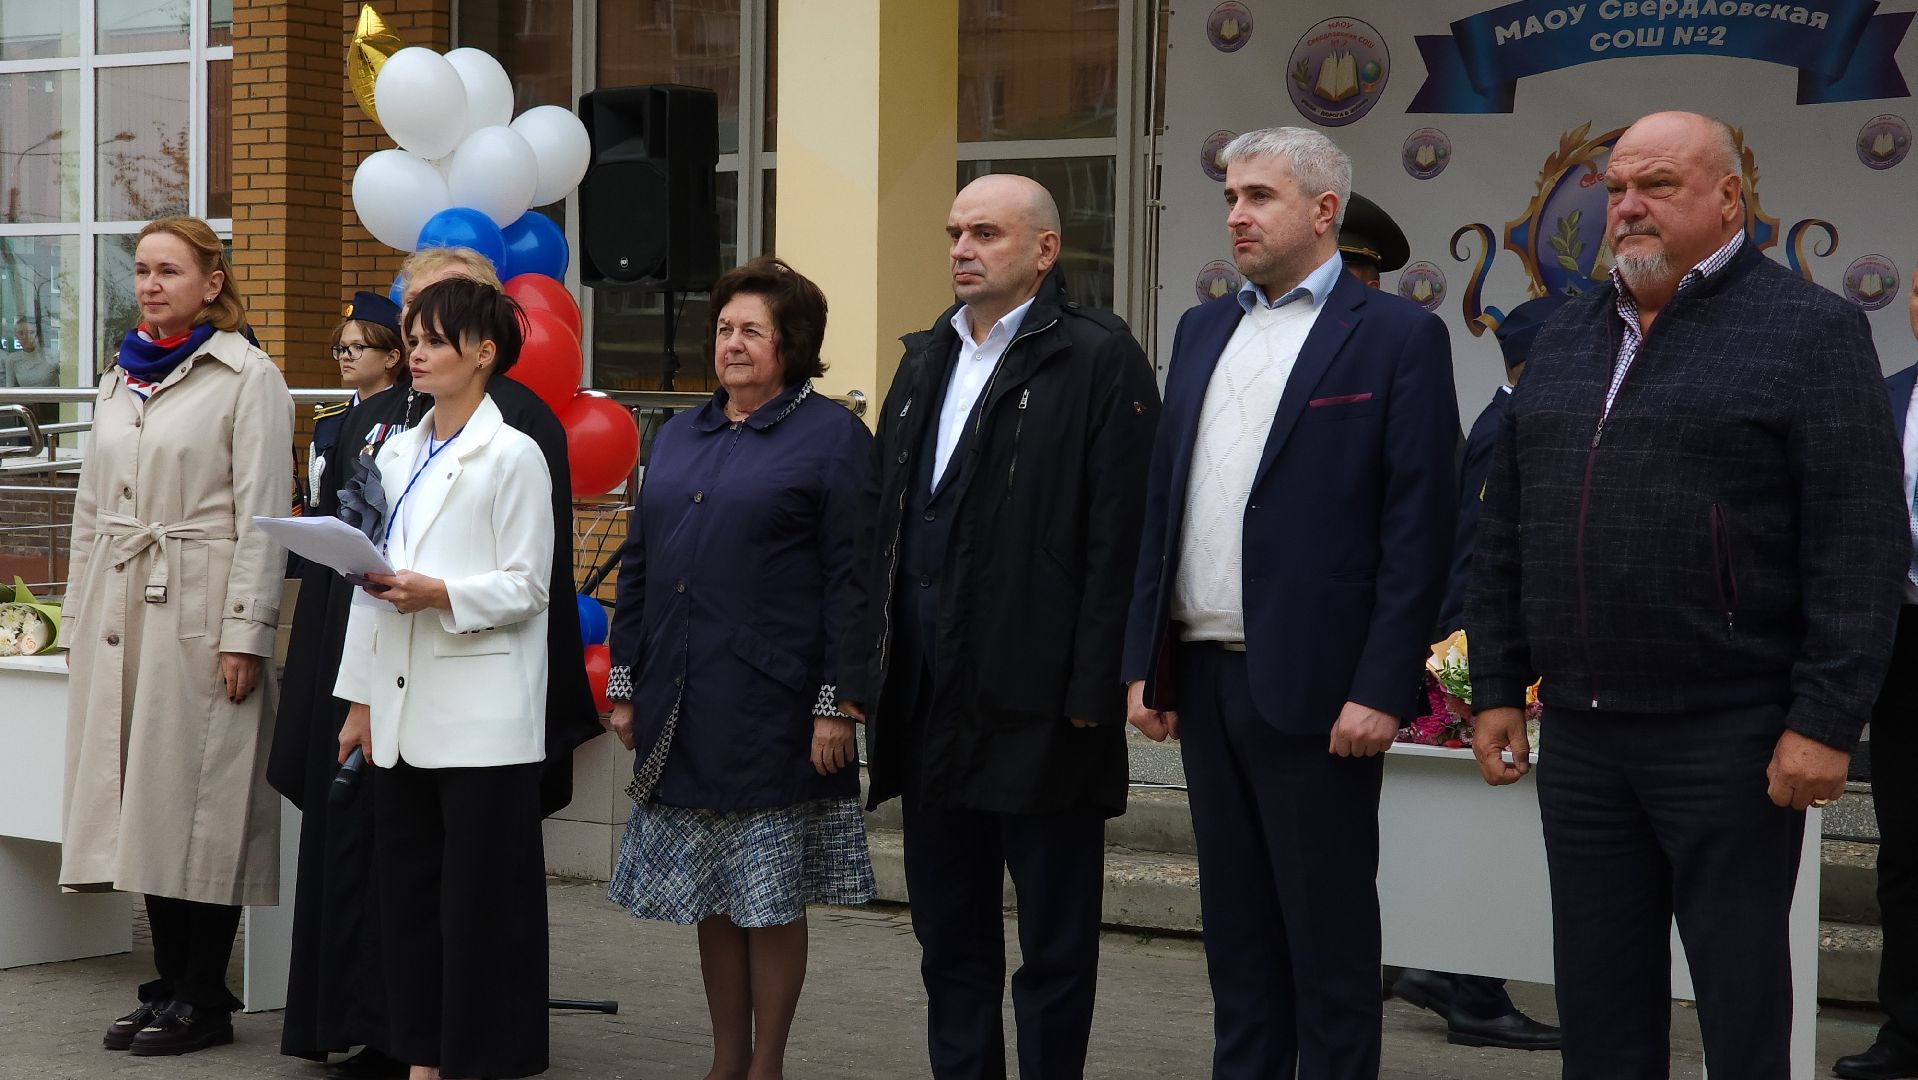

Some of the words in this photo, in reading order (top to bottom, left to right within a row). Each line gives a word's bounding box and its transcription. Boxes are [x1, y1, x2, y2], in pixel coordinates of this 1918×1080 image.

[1495, 4, 1587, 46] МАОУ
[1598, 0, 1829, 30] Свердловская
[1589, 27, 1665, 52] СОШ
[1672, 26, 1727, 46] №2
